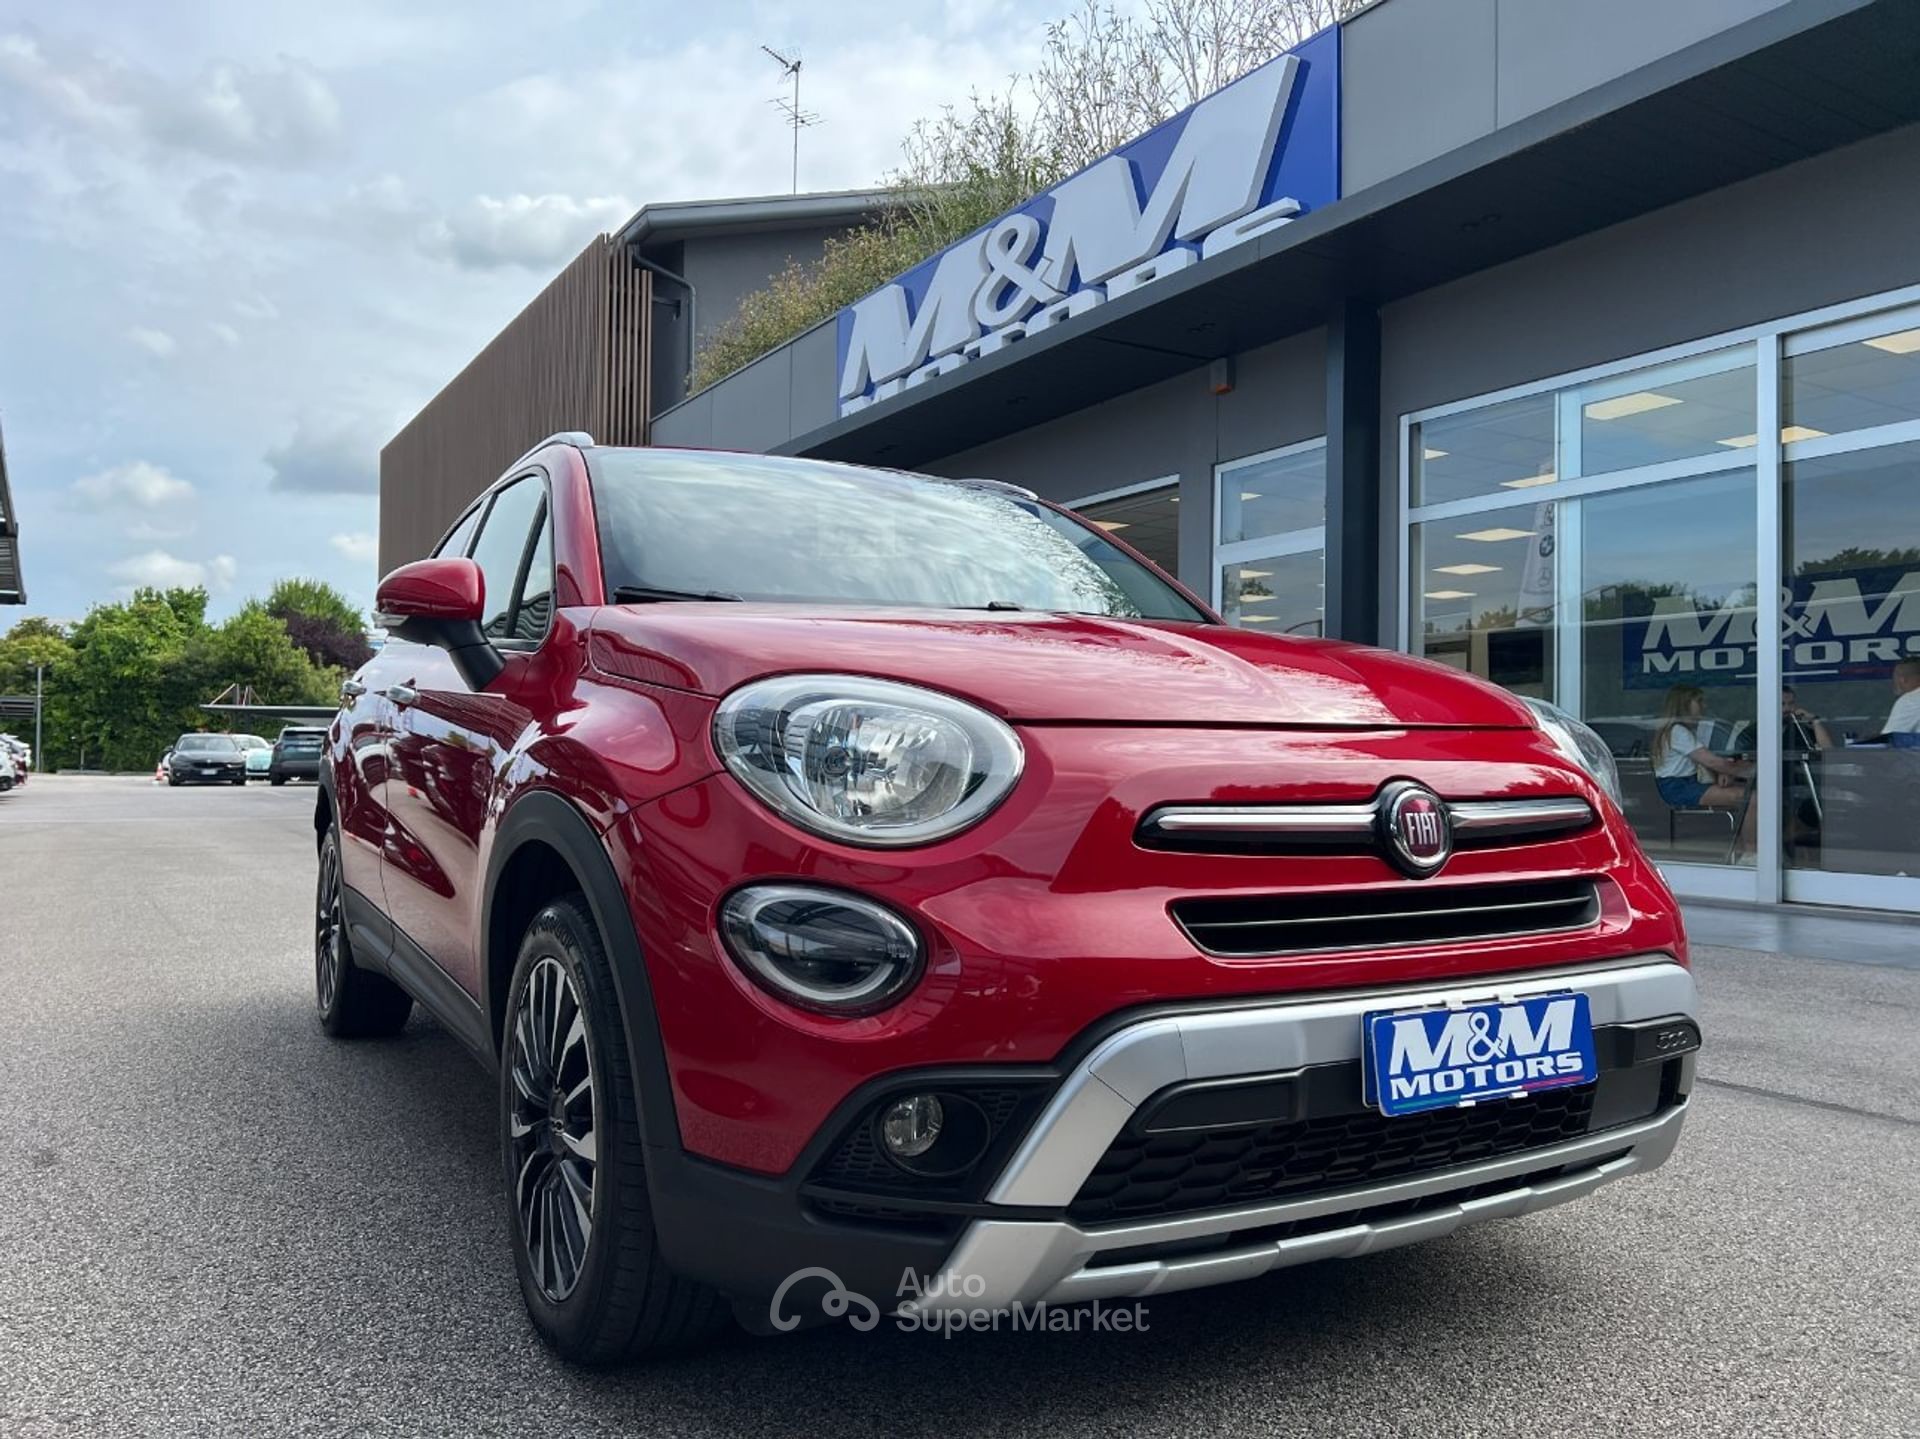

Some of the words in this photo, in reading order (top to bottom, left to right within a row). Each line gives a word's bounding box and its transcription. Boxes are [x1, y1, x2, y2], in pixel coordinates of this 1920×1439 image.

[840, 54, 1300, 398] M&M
[1405, 812, 1438, 845] FIAT
[1389, 999, 1577, 1076] M&M
[1390, 1052, 1584, 1100] MOTORS
